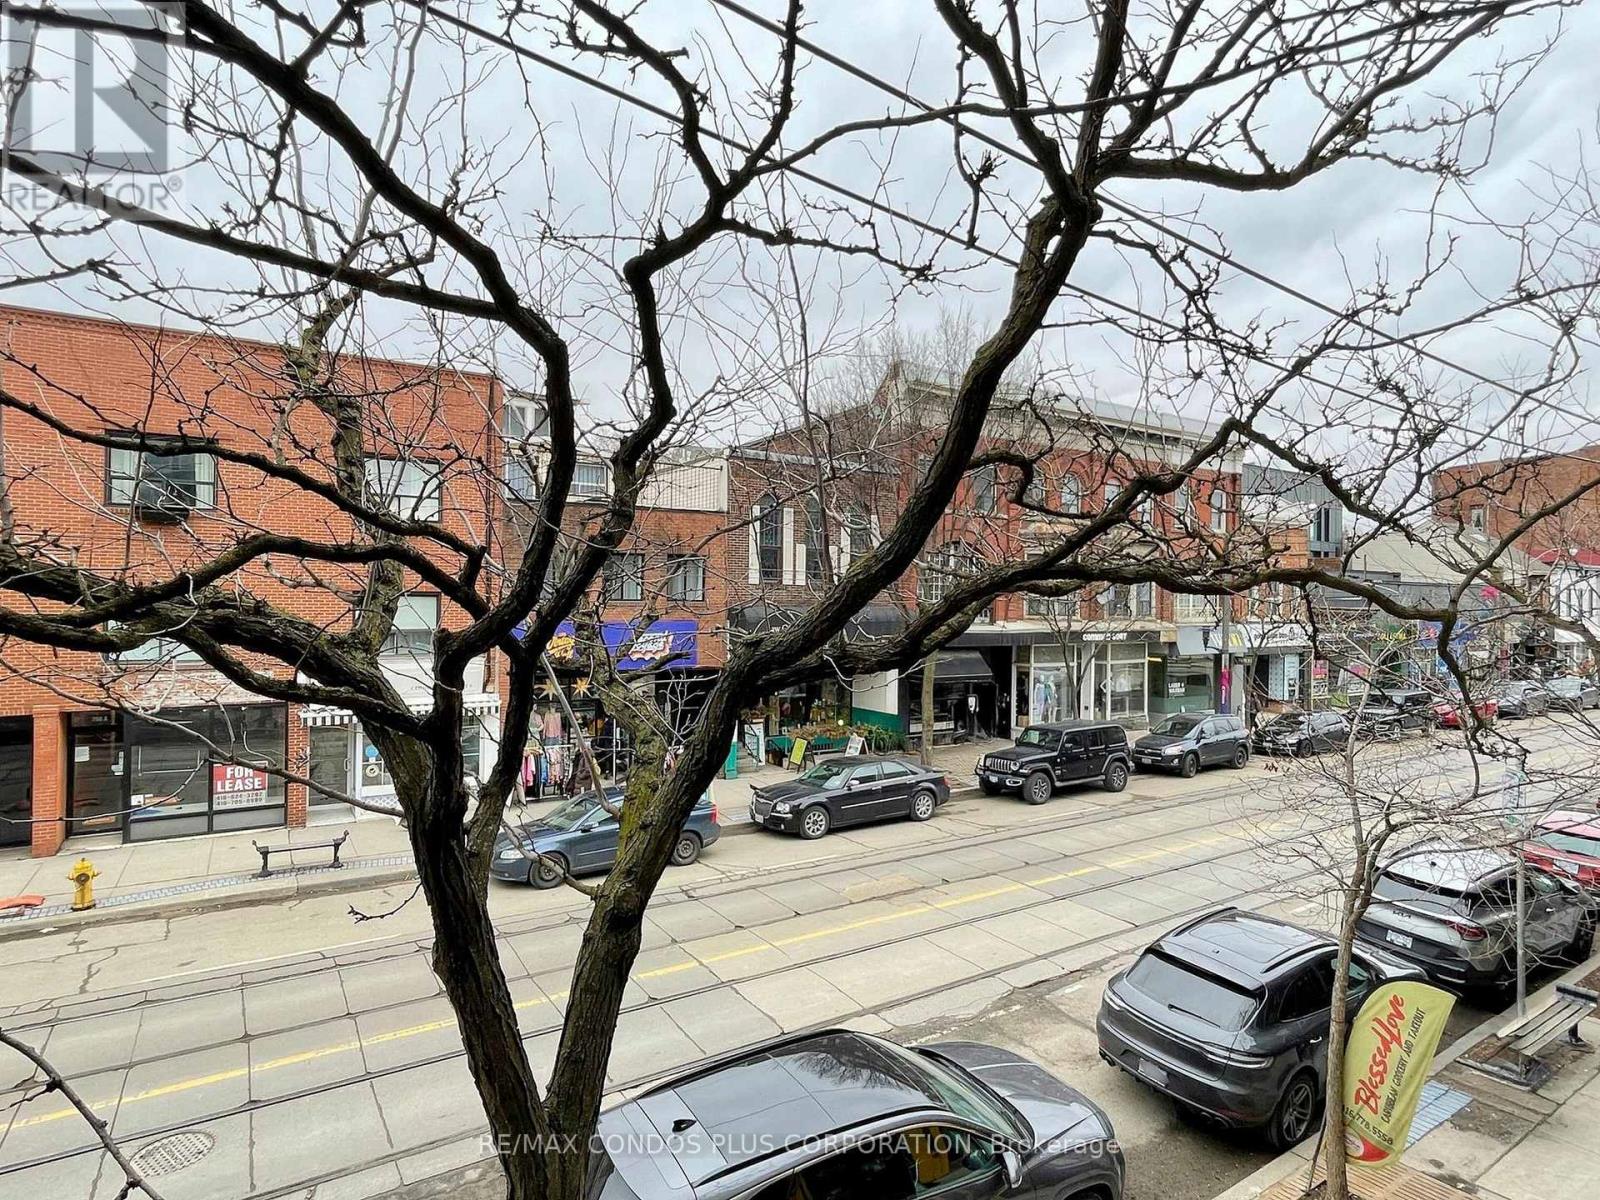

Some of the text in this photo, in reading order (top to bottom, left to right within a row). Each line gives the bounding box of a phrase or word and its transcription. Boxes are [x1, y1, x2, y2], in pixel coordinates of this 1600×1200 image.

[226, 765, 253, 779] FOR
[216, 777, 263, 792] LEASE
[1381, 1086, 1399, 1124] CARIBBEAN
[1395, 1054, 1409, 1087] GROCERY
[1407, 1007, 1426, 1040] TAKEOUT
